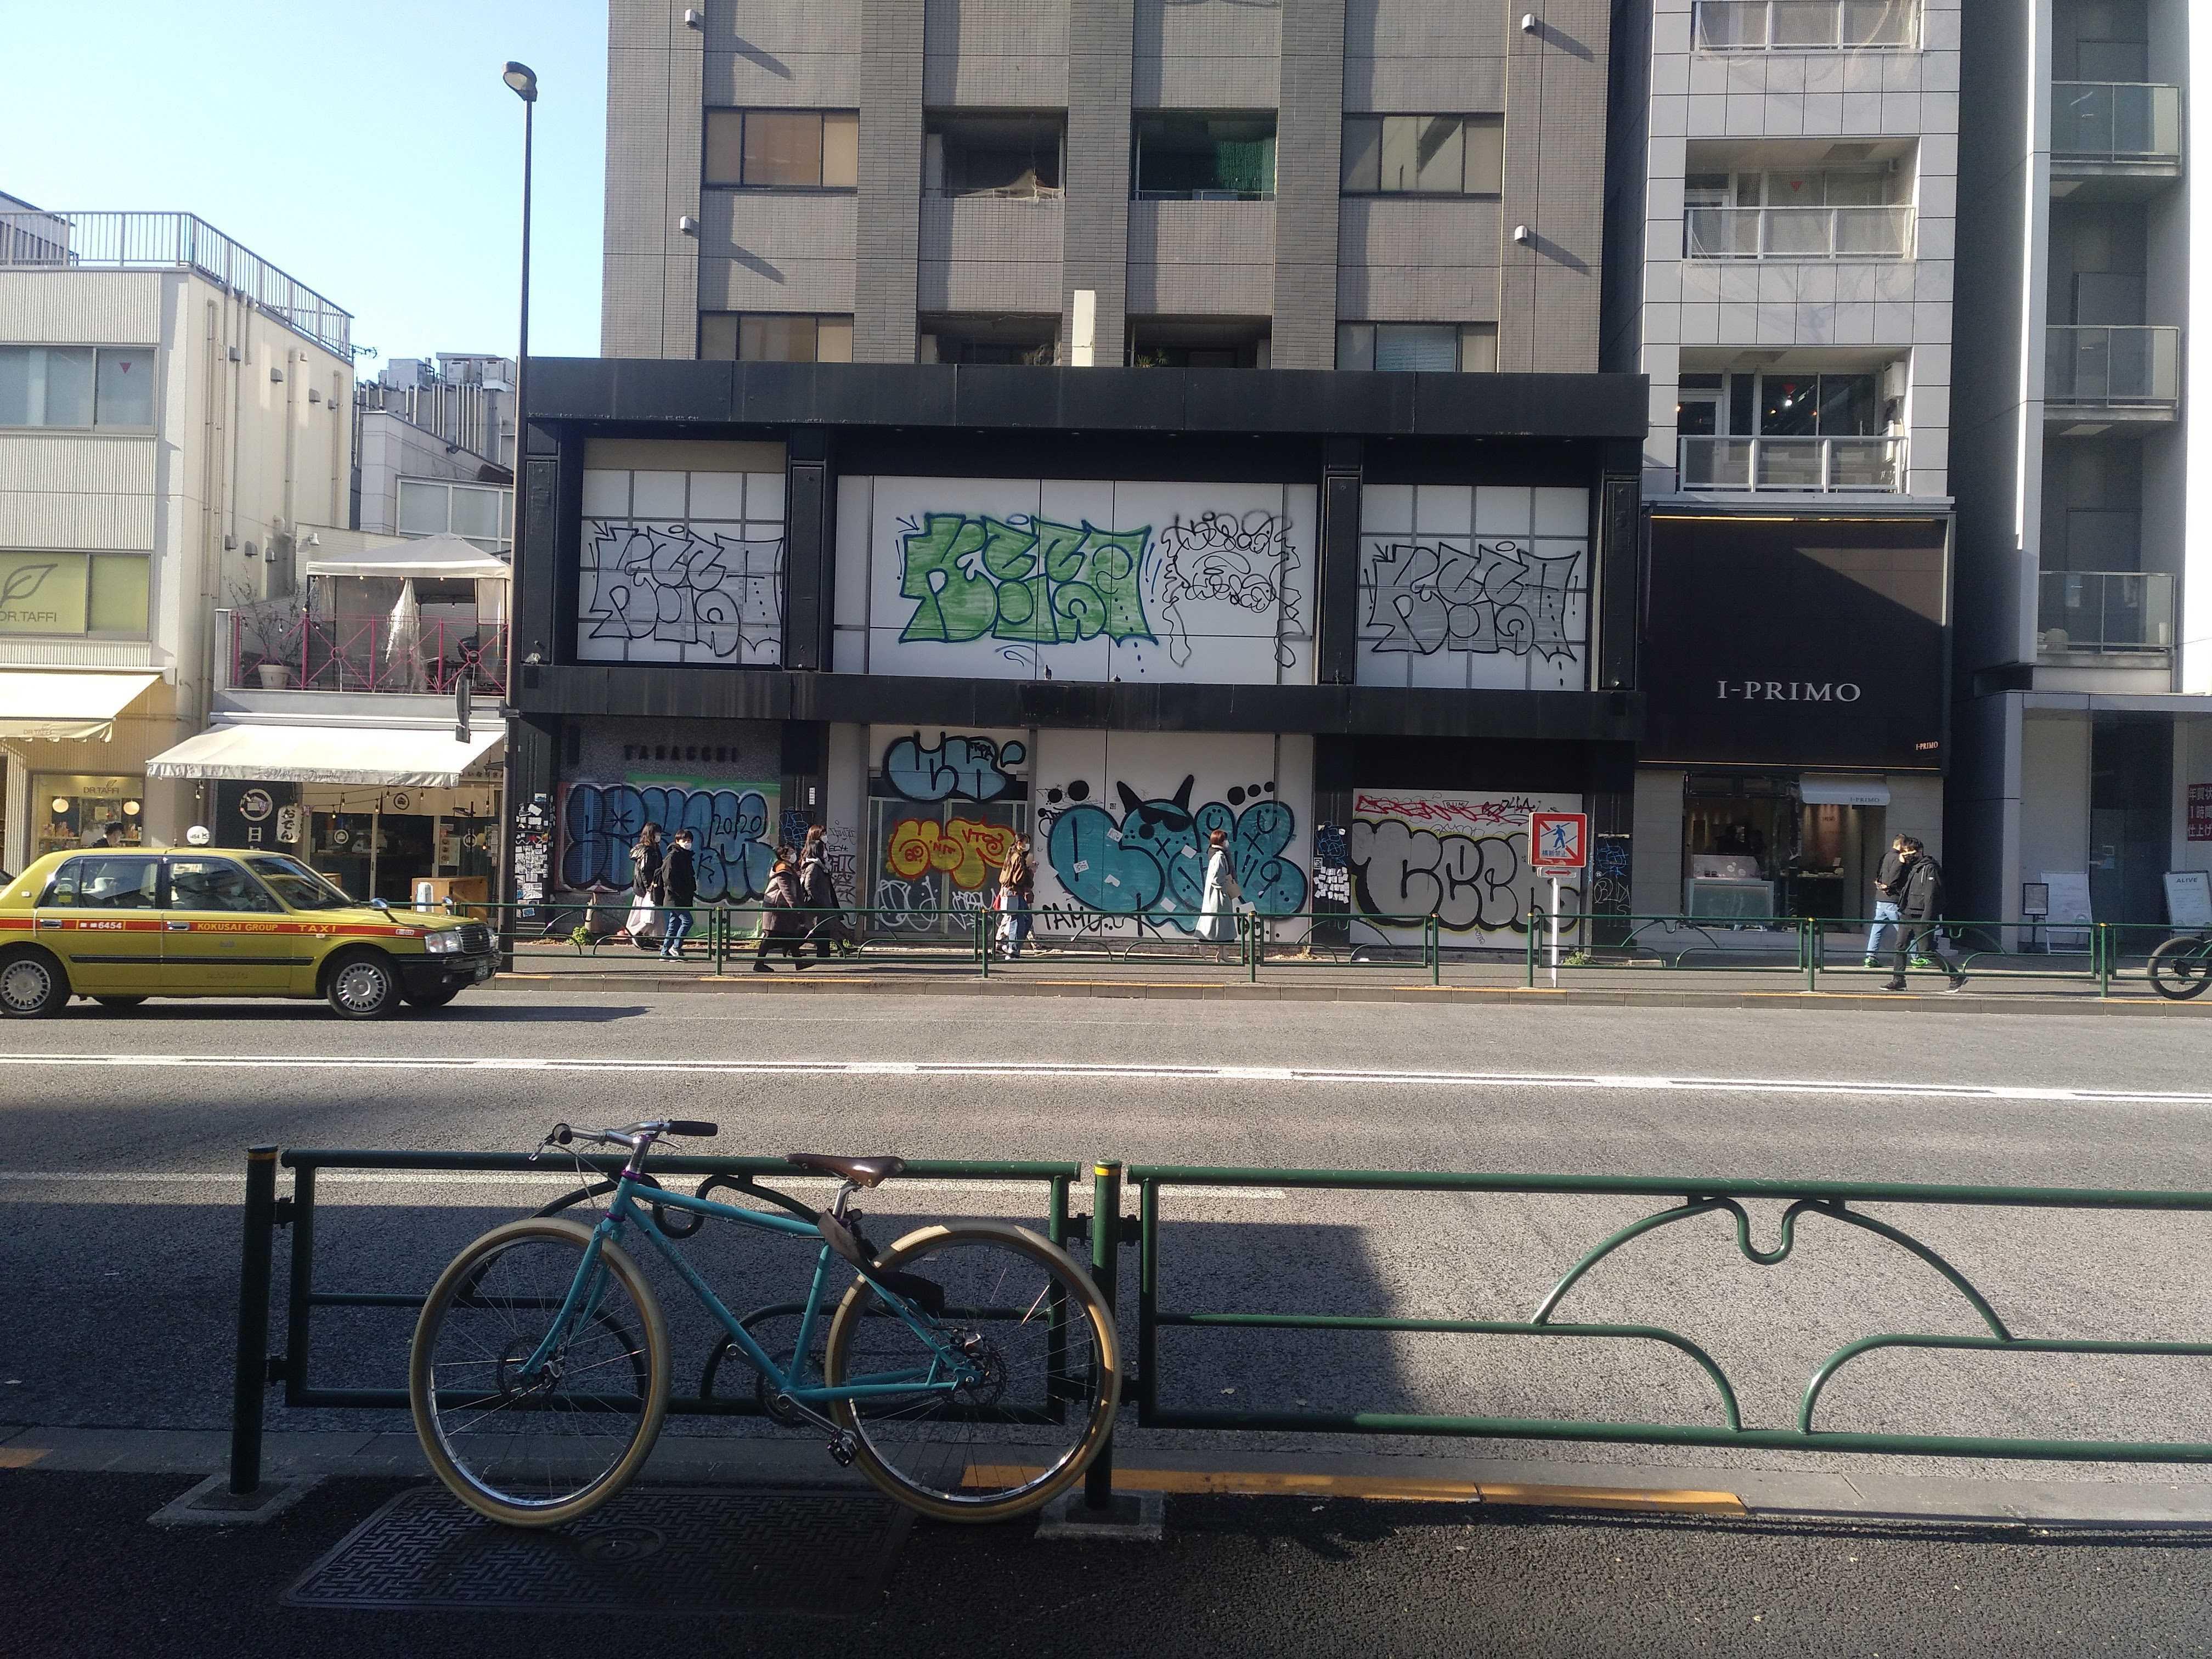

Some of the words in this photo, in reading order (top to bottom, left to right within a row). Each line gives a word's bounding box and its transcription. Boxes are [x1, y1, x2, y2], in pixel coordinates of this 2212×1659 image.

[0, 611, 57, 622] DR.TAFFI
[1717, 680, 1861, 702] I-PRIMO
[1916, 741, 1938, 751] I-PRIMO
[281, 809, 296, 840] おでん
[198, 923, 241, 931] KOKUSAI
